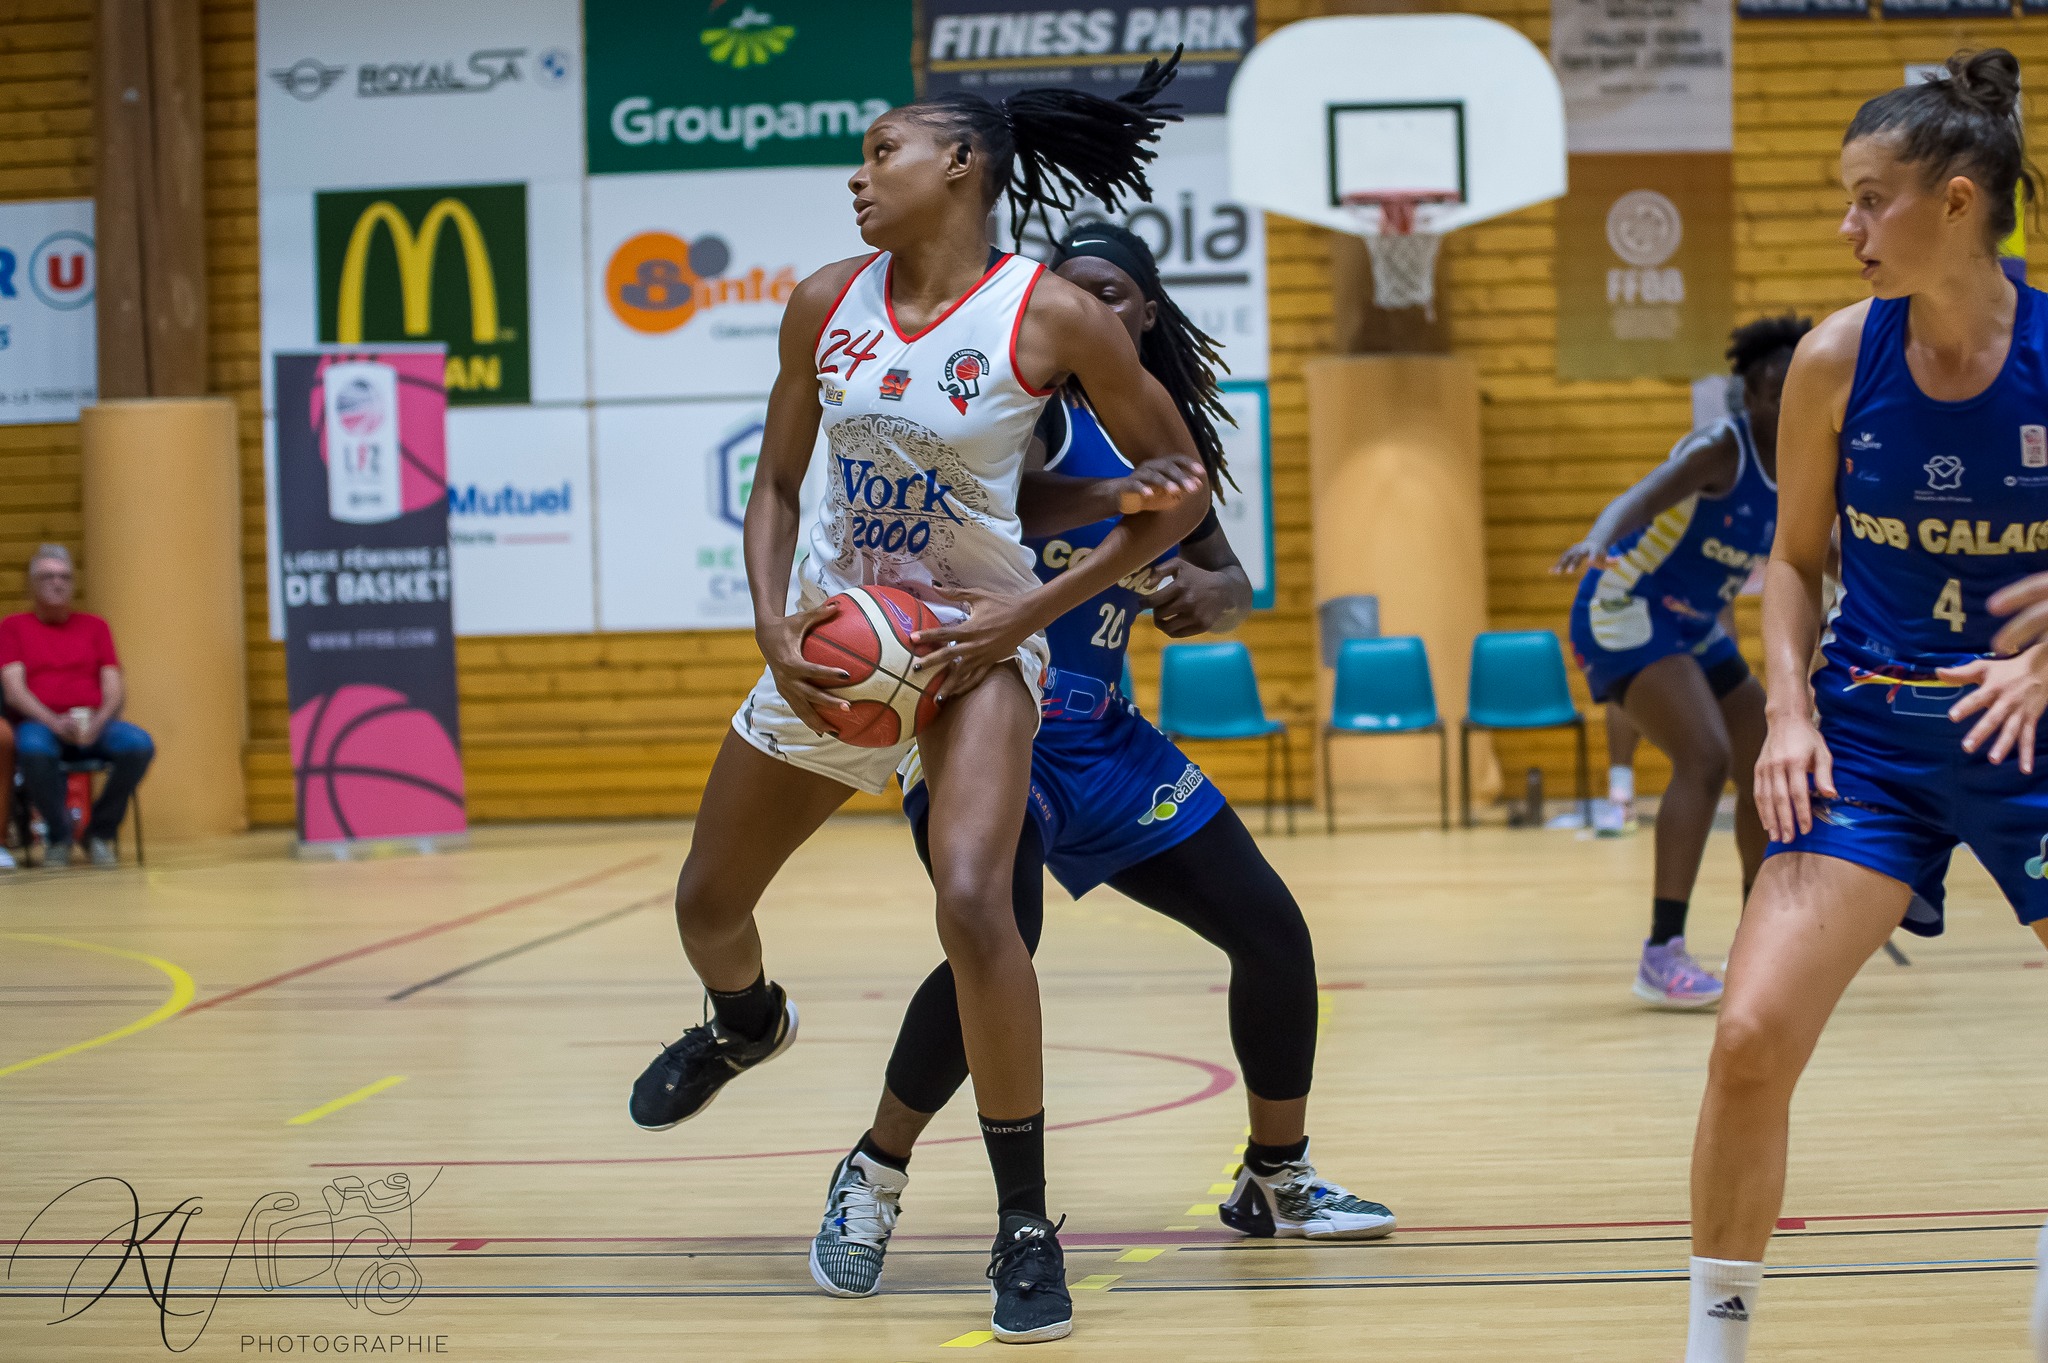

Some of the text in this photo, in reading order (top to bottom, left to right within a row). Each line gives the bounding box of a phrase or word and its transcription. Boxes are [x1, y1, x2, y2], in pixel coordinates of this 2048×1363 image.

[930, 5, 1250, 58] FITNESS PARK
[356, 60, 466, 97] ROYAL
[610, 95, 891, 152] Groupama
[47, 255, 86, 293] U
[819, 328, 885, 381] 24
[447, 480, 571, 519] Mutuel
[852, 517, 931, 554] 2000
[1844, 504, 1912, 551] COB
[285, 569, 448, 607] DE BASKET
[1932, 577, 1968, 633] 4
